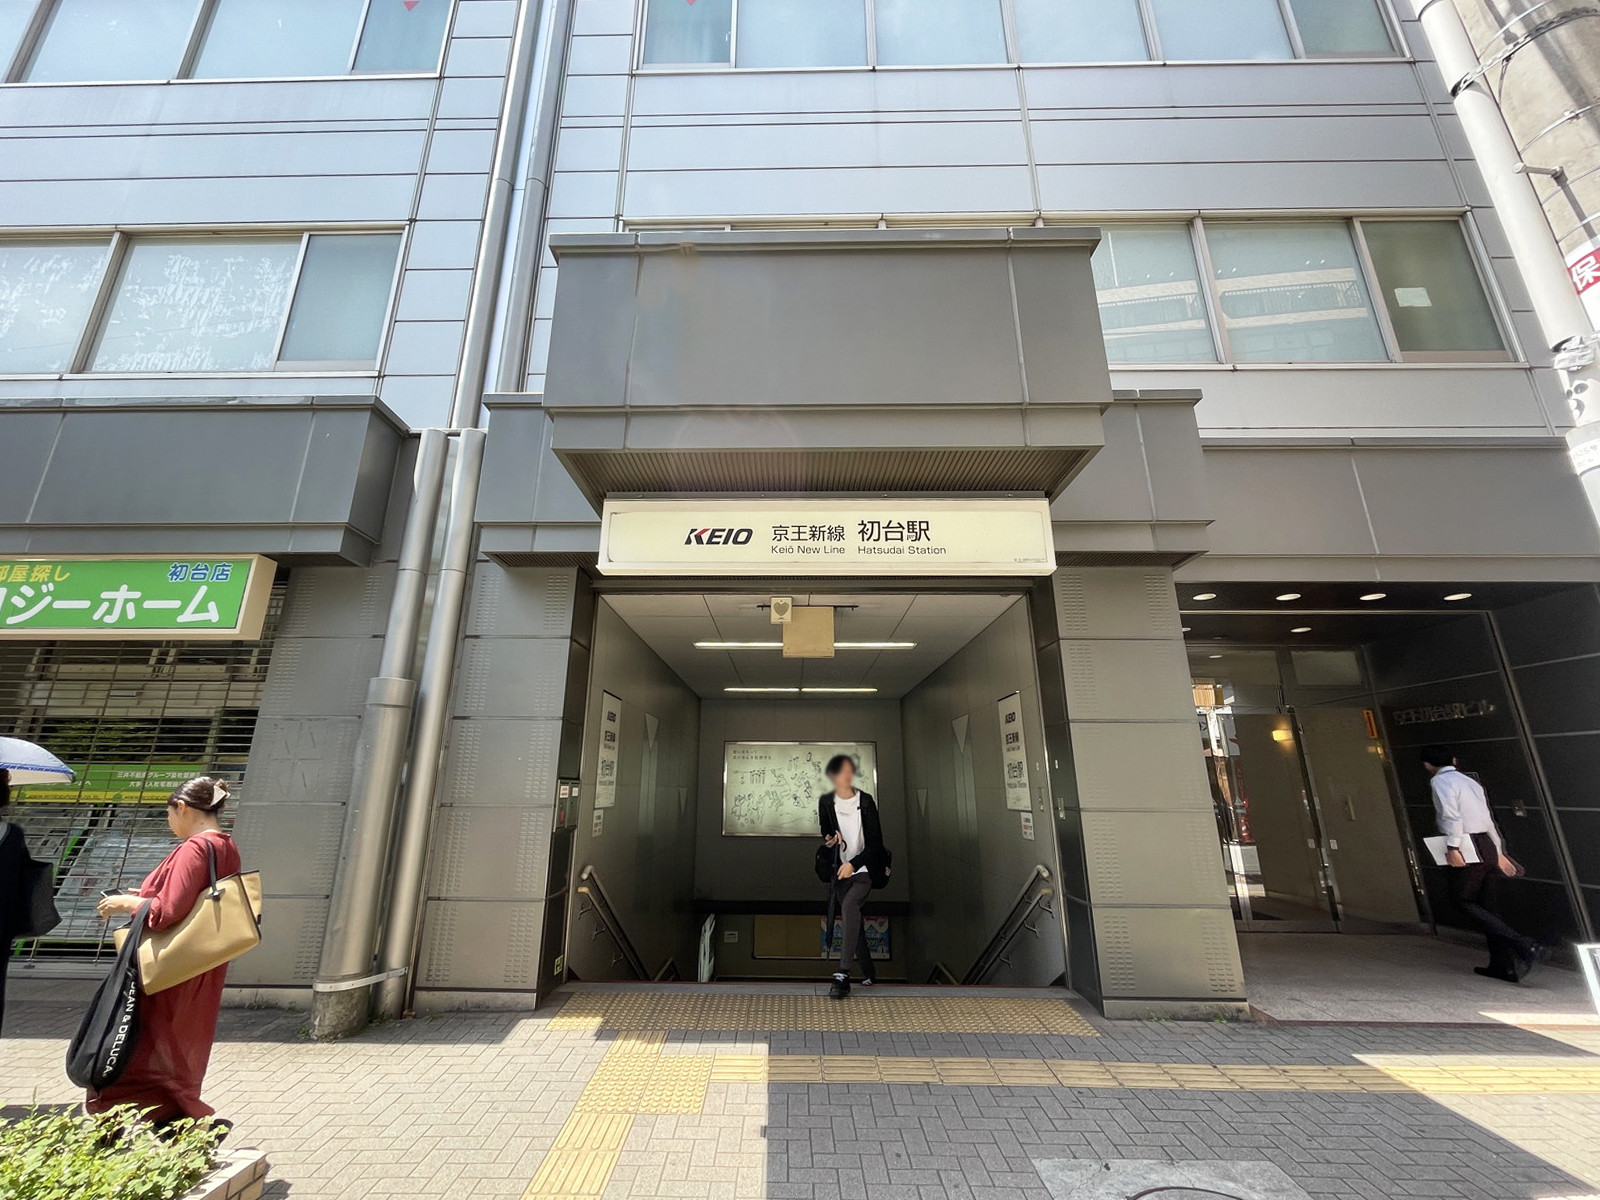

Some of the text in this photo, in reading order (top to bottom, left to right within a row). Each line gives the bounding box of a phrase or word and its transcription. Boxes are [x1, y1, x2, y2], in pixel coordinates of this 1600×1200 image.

[684, 520, 931, 546] KEIO 京王新線 初台駅
[797, 546, 821, 555] New
[824, 545, 846, 555] Line
[857, 545, 905, 555] Hatsudai
[908, 545, 947, 555] Station
[168, 562, 233, 582] 初台店
[0, 582, 220, 625] ジーホーム
[121, 1014, 131, 1023] &
[102, 1025, 128, 1077] DELUCA
